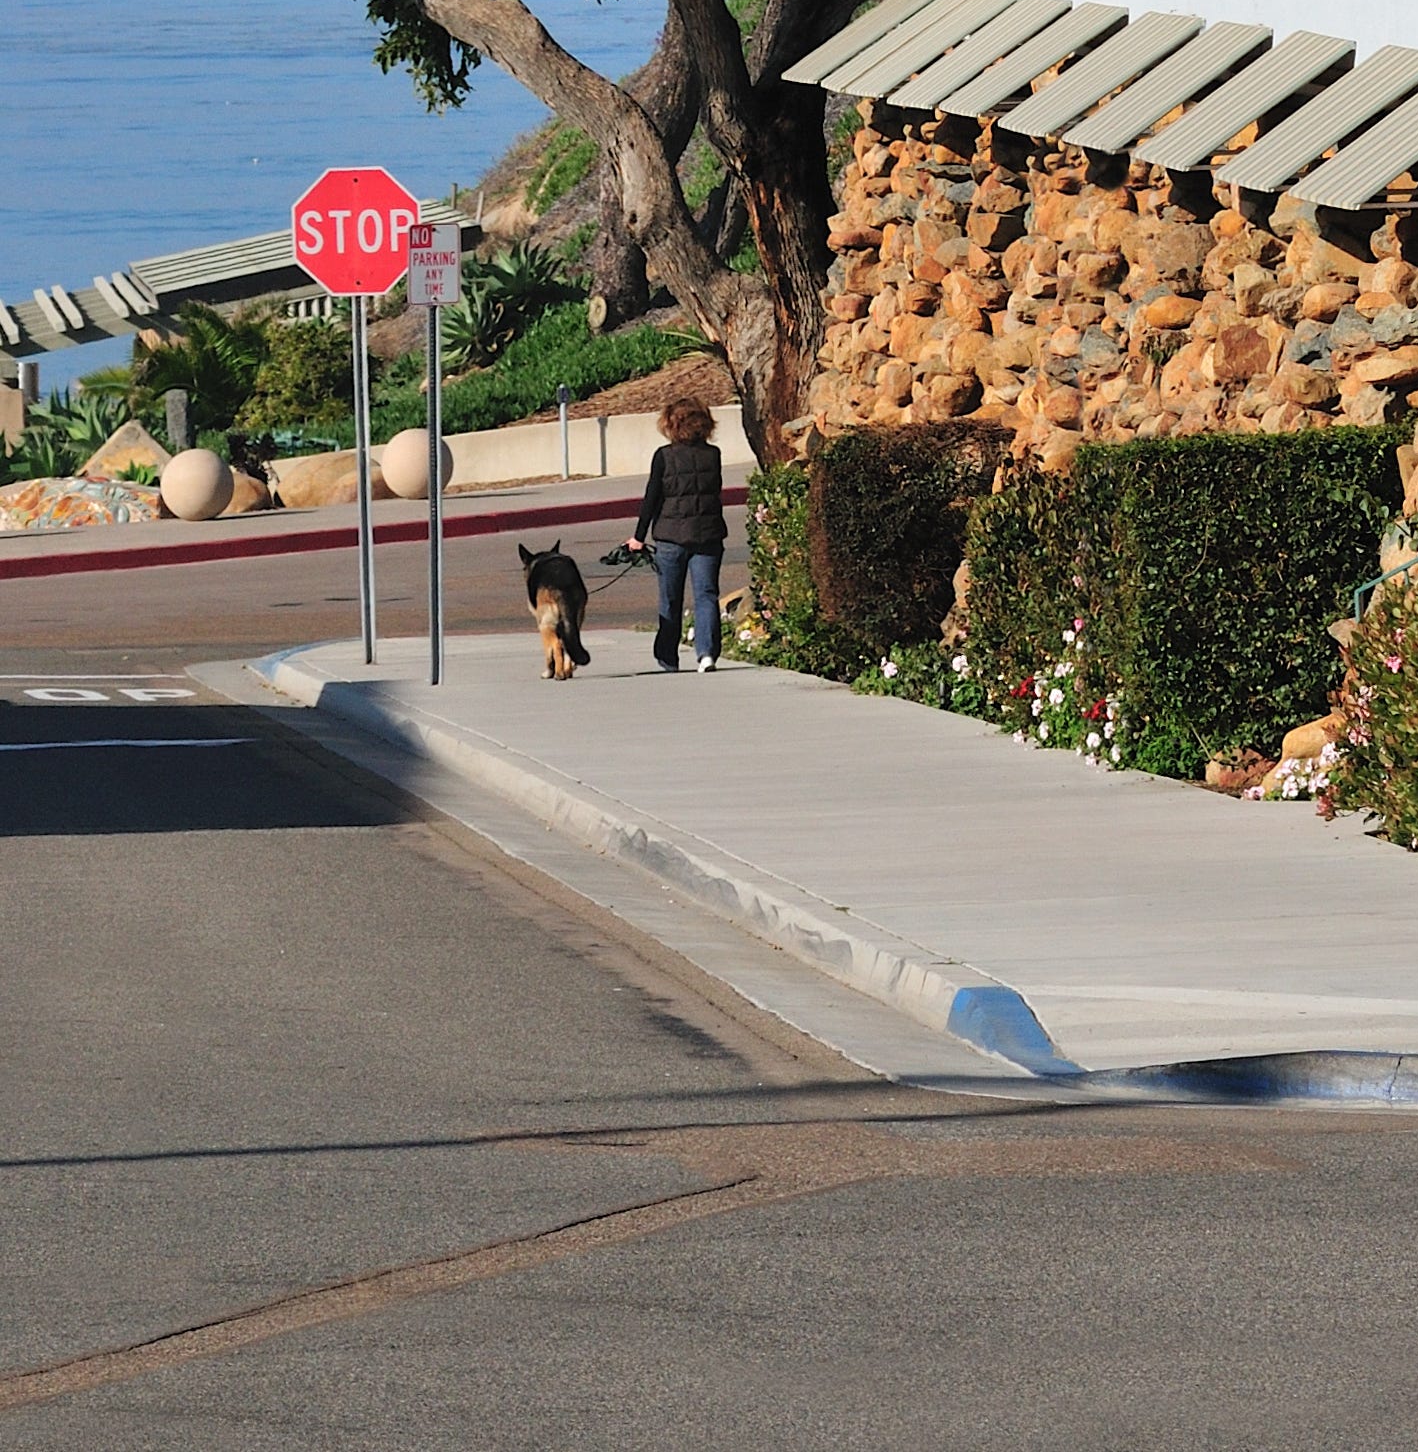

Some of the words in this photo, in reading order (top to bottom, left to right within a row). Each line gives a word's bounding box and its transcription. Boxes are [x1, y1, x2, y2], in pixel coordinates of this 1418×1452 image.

[298, 208, 414, 255] STOP
[411, 228, 429, 245] NO
[412, 251, 457, 266] PARKING
[425, 269, 443, 279] ANY
[424, 283, 444, 295] TIME
